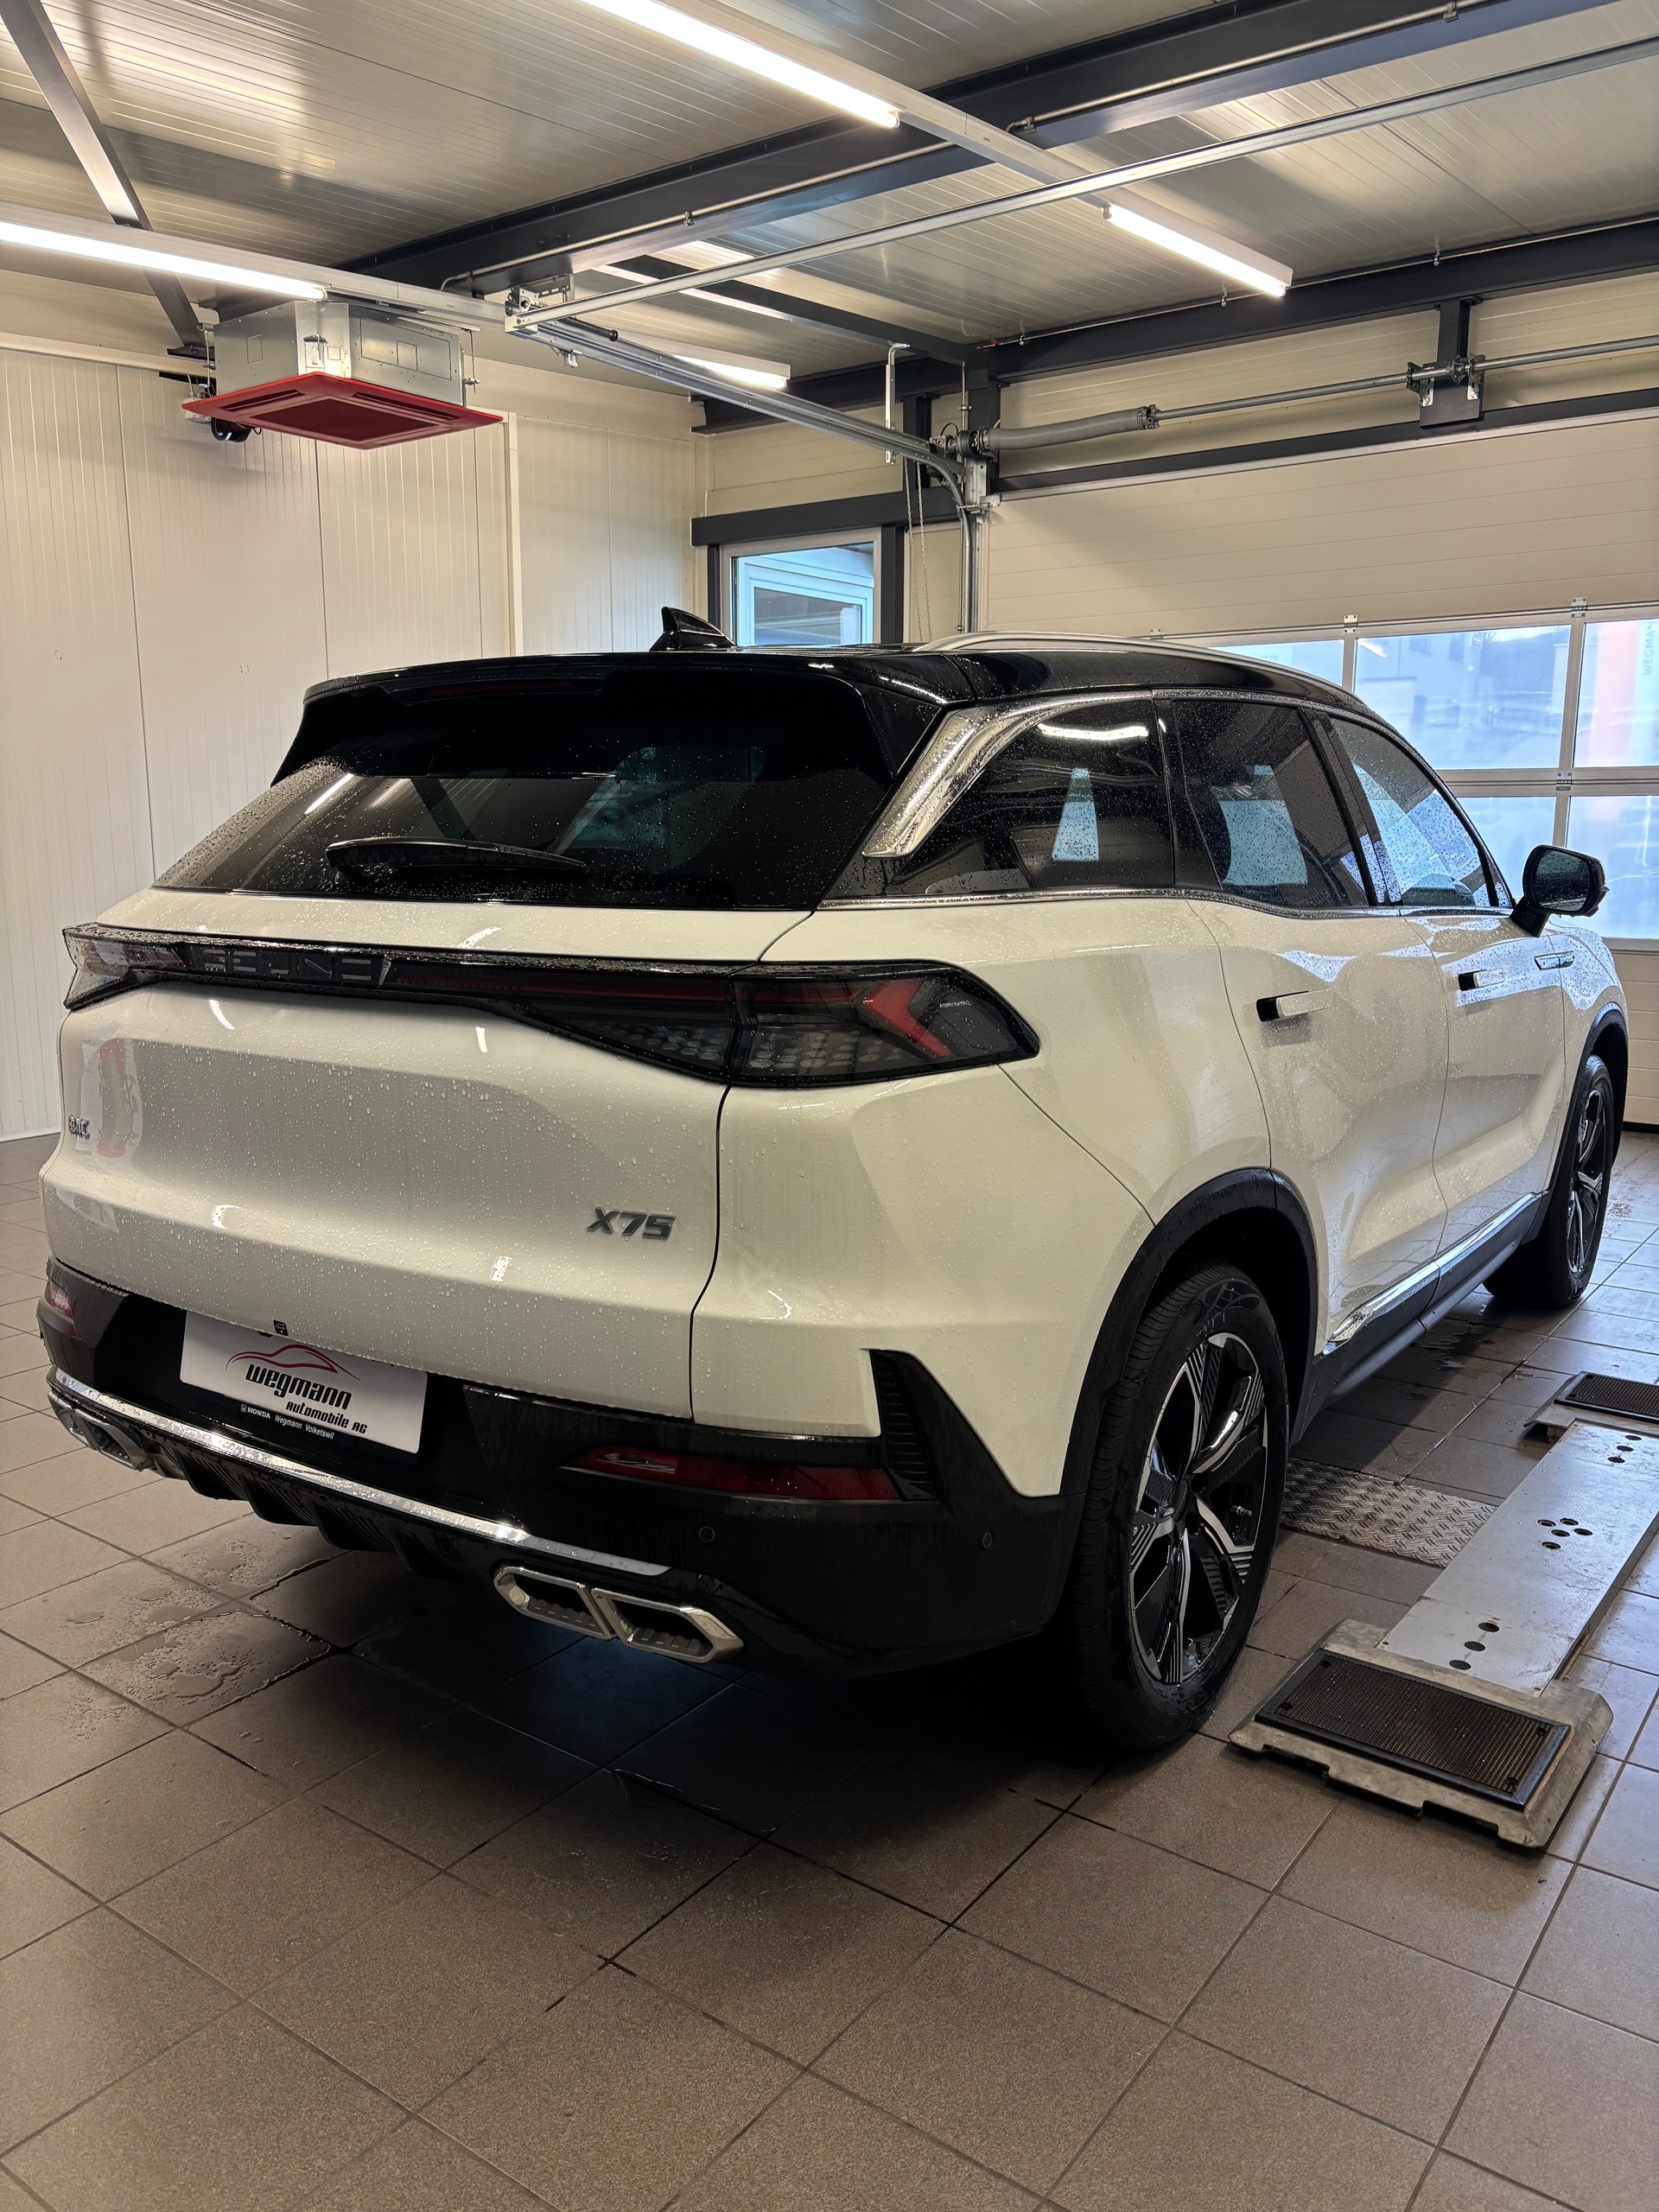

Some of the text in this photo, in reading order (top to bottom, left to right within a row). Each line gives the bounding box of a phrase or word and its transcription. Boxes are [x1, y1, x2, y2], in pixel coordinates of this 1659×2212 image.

[586, 1206, 676, 1241] X75
[245, 1363, 353, 1410] wegmann
[247, 1407, 335, 1440] HONDA Wegmann Volketswil
[351, 1421, 368, 1434] AG
